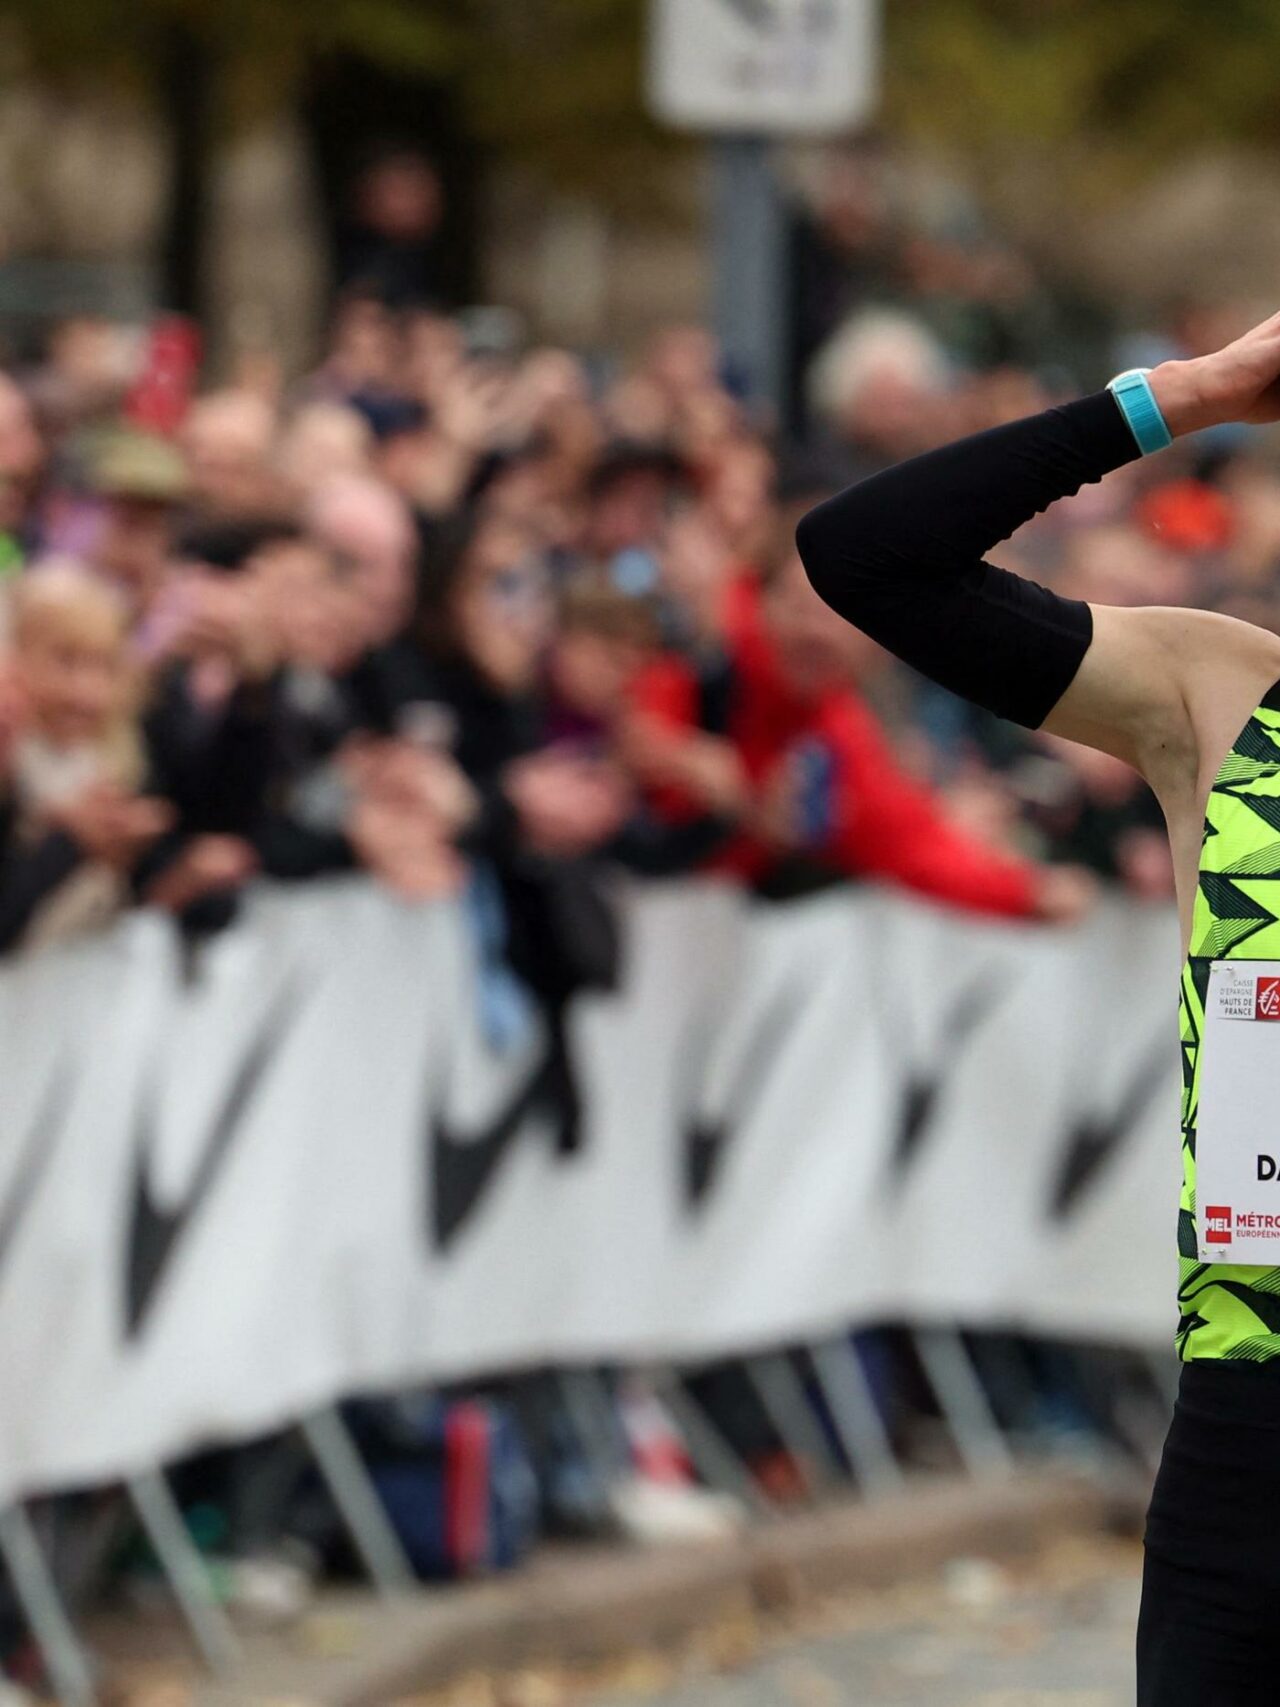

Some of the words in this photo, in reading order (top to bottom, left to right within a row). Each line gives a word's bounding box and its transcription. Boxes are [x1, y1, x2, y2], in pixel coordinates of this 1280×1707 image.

[1219, 997, 1241, 1006] HAUTS
[1243, 998, 1252, 1006] DE
[1225, 1007, 1252, 1016] FRANCE
[1206, 1217, 1231, 1232] MEL
